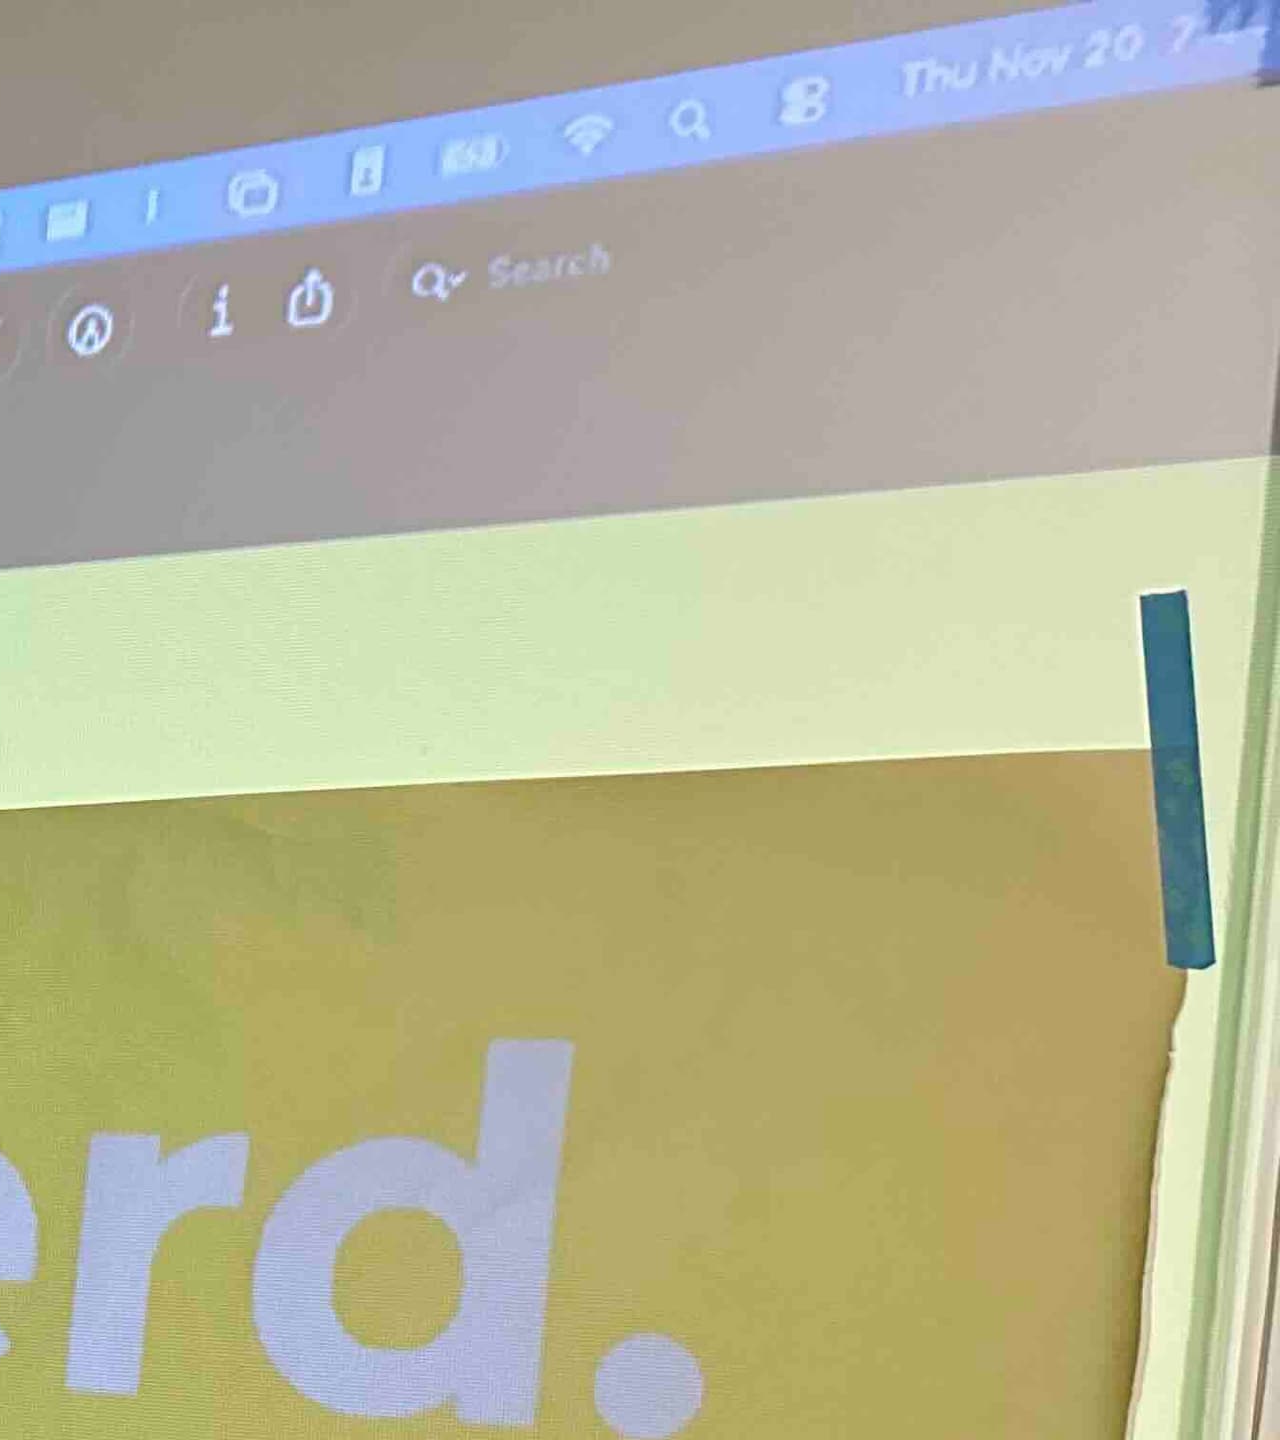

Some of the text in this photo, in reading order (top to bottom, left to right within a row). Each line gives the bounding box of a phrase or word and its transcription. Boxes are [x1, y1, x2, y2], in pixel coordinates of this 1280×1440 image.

[900, 57, 979, 97] Thu
[988, 45, 1072, 82] Nov
[1083, 24, 1144, 69] 20
[487, 240, 612, 290] Search
